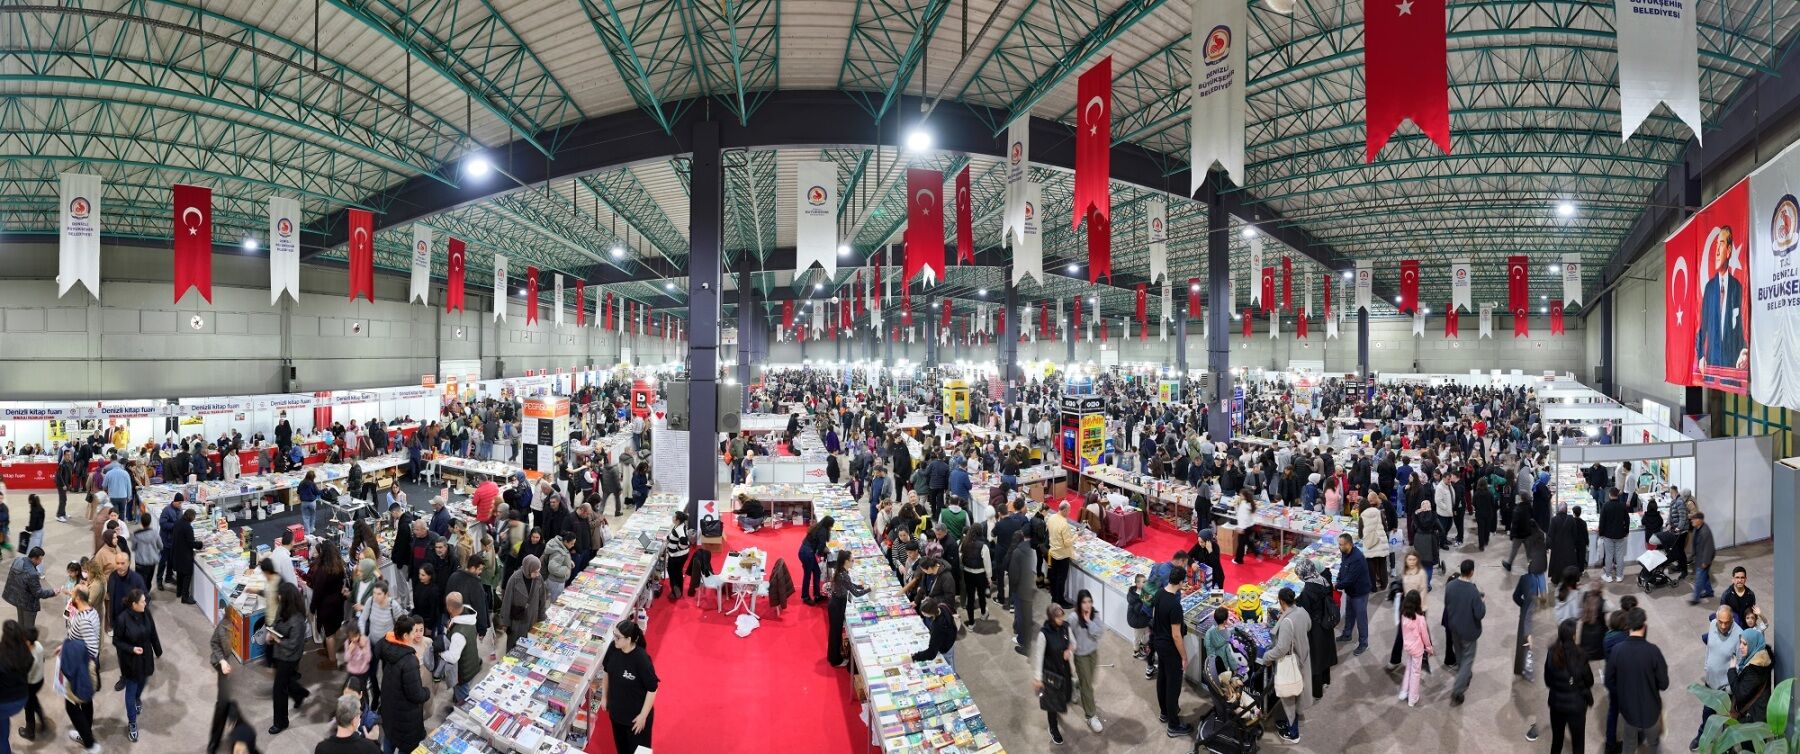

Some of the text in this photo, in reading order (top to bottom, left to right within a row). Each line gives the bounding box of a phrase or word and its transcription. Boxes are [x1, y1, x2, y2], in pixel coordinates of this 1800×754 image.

[1633, 6, 1680, 18] BELEDİYESİ
[5, 408, 28, 416] Denizli
[29, 408, 46, 416] kitap
[124, 406, 141, 414] kitap
